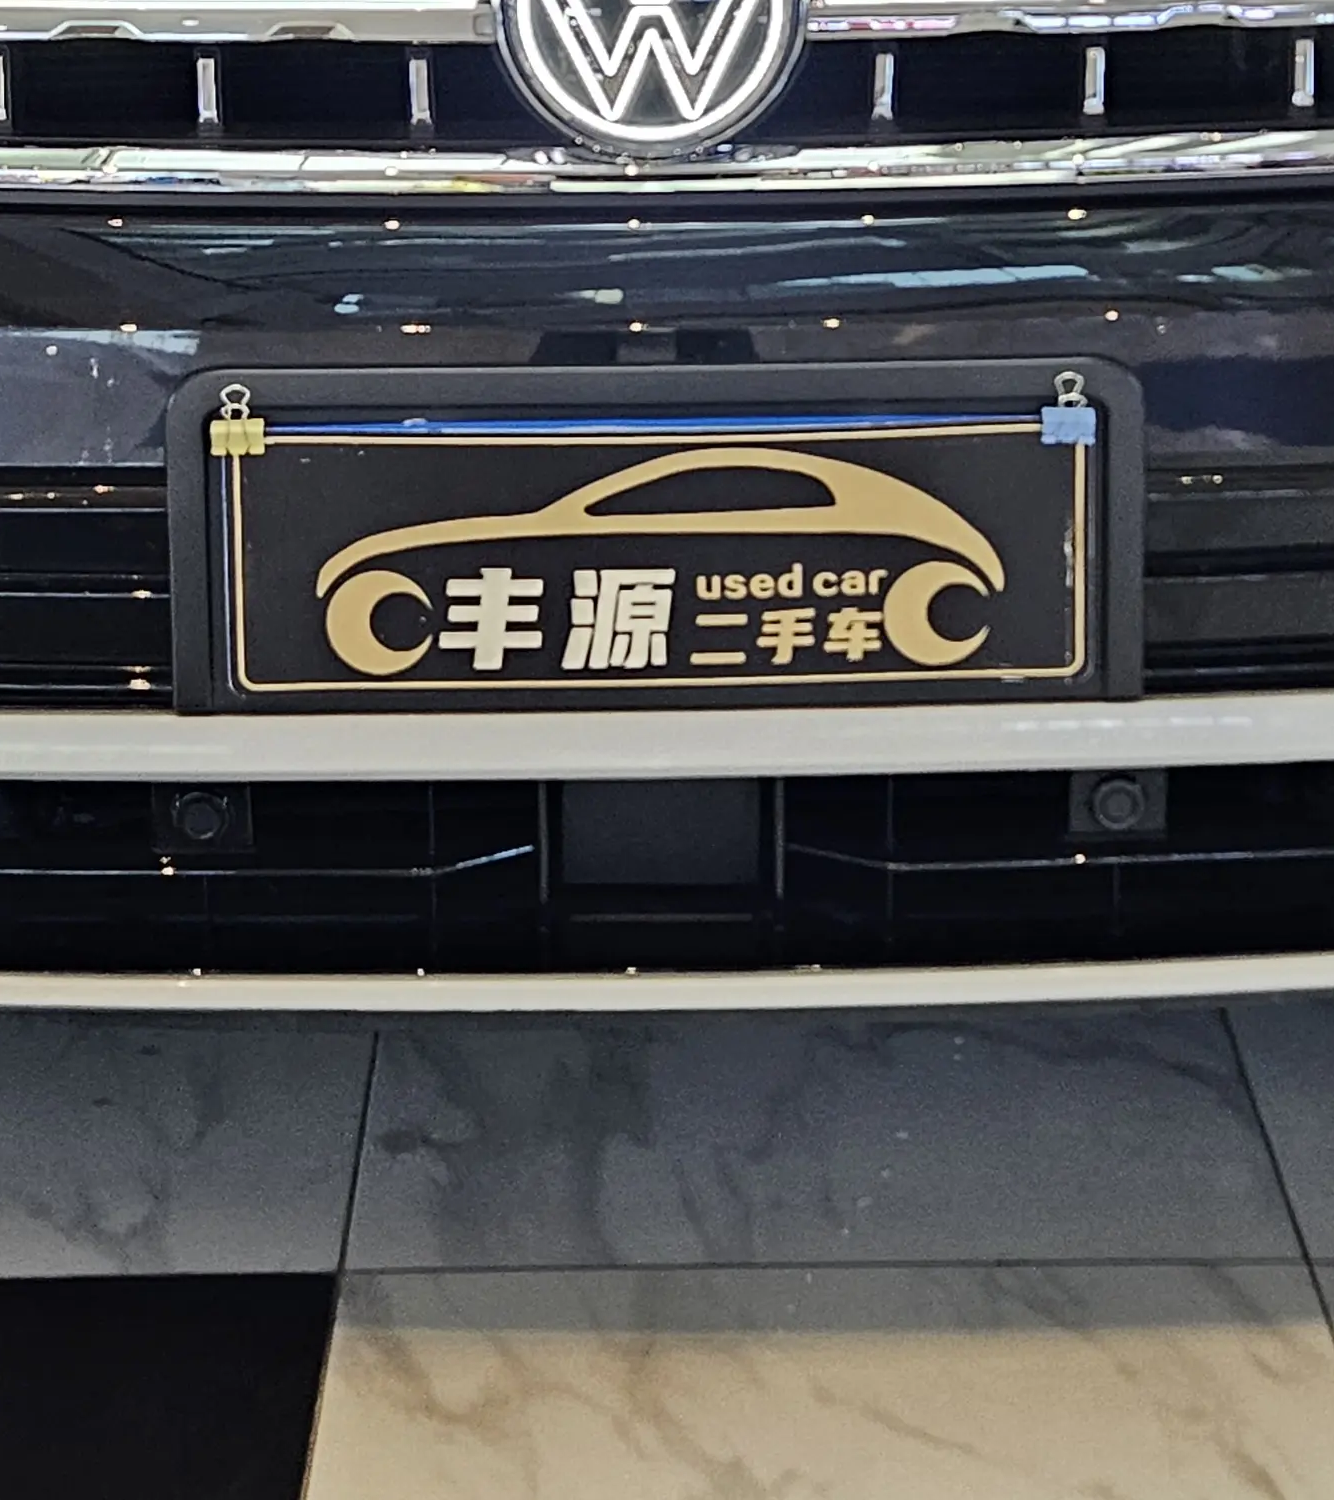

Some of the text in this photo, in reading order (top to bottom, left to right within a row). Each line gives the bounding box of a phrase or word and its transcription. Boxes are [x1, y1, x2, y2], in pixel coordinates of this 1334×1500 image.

[696, 563, 888, 601] used car
[438, 567, 675, 671] 丰源
[690, 607, 885, 666] 二手车
